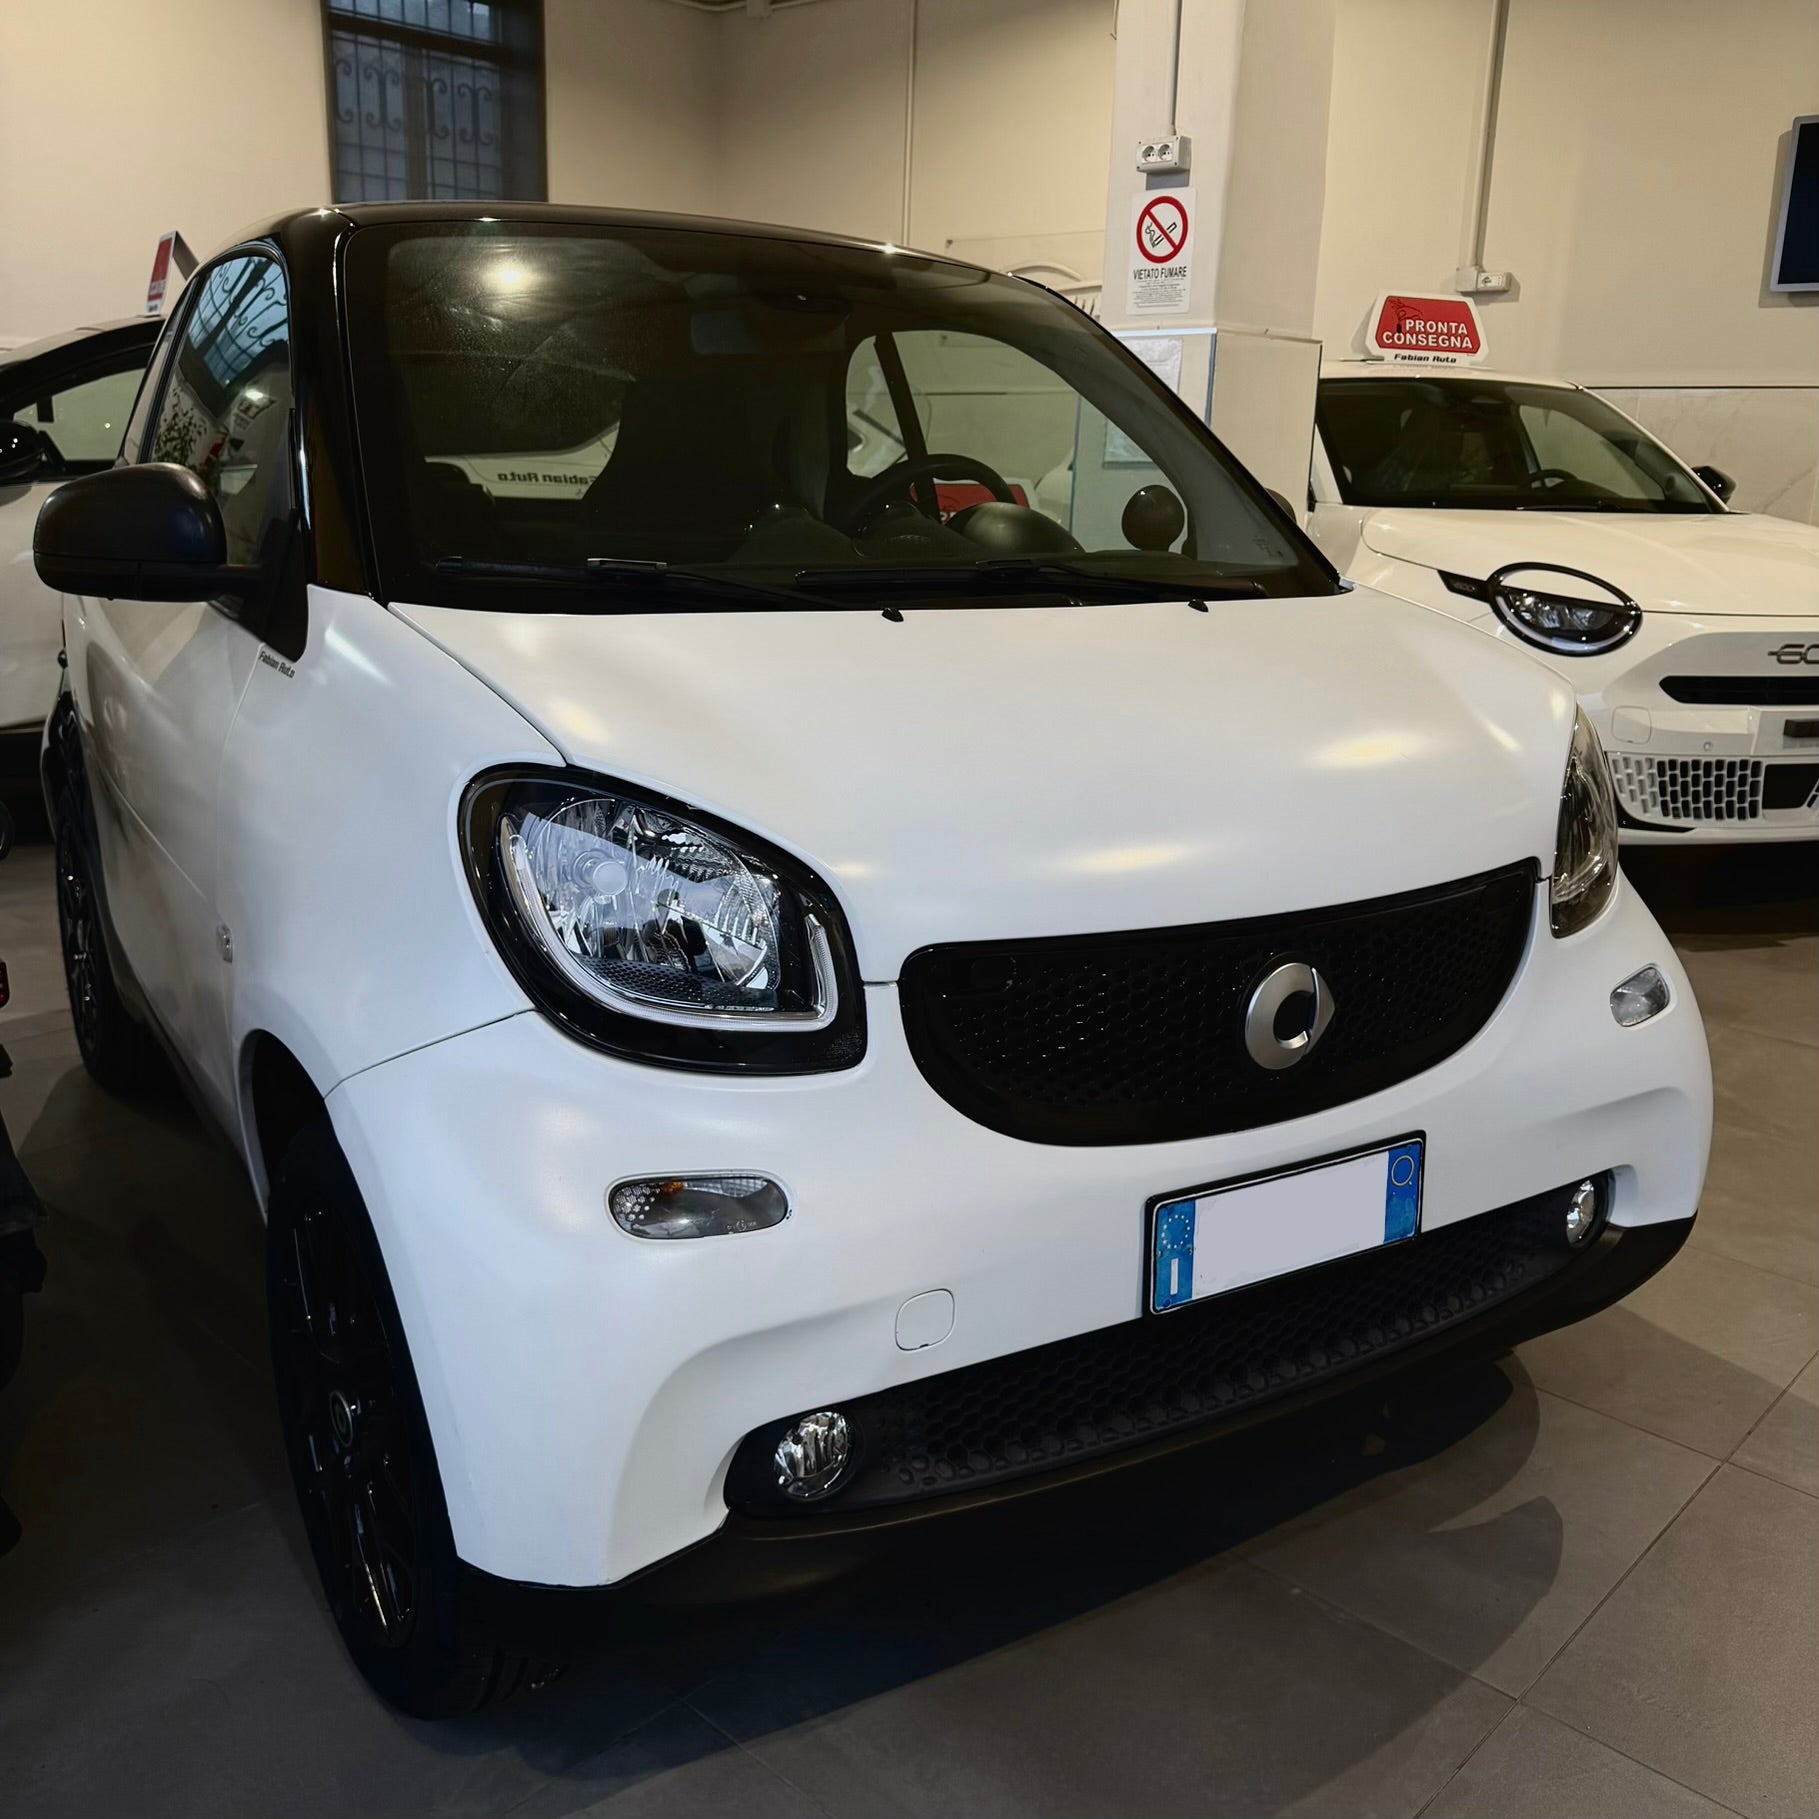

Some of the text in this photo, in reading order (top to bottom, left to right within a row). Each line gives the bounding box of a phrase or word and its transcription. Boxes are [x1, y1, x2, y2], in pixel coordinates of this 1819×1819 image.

[1133, 266, 1187, 280] VIETATO FUMARE
[1405, 319, 1467, 334] PRONTA
[1382, 331, 1473, 349] CONSEGNA
[1394, 353, 1430, 362] Fabian
